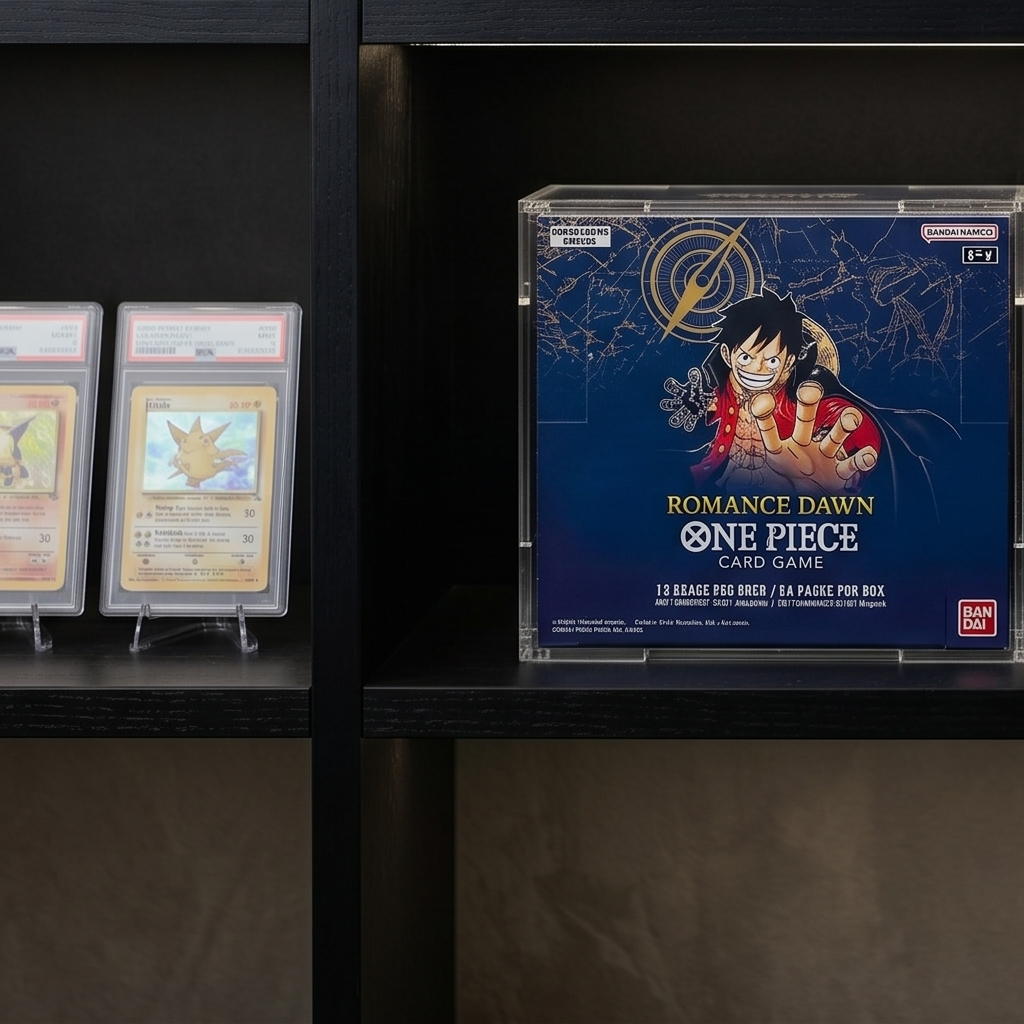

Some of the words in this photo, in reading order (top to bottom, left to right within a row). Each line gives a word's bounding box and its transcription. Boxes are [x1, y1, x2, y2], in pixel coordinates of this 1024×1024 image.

[926, 228, 959, 236] BANDAI
[960, 228, 993, 236] NAMCO
[666, 495, 791, 515] ROMANCE
[797, 495, 875, 515] DAWN
[244, 508, 256, 518] 30
[39, 533, 51, 543] 30
[242, 534, 255, 544] 30
[680, 520, 757, 553] ONE
[765, 523, 859, 553] PIECE
[718, 555, 766, 569] CARD
[772, 555, 824, 569] GAME
[862, 584, 886, 597] BOX
[963, 606, 992, 618] BAN
[963, 618, 986, 630] DAI
